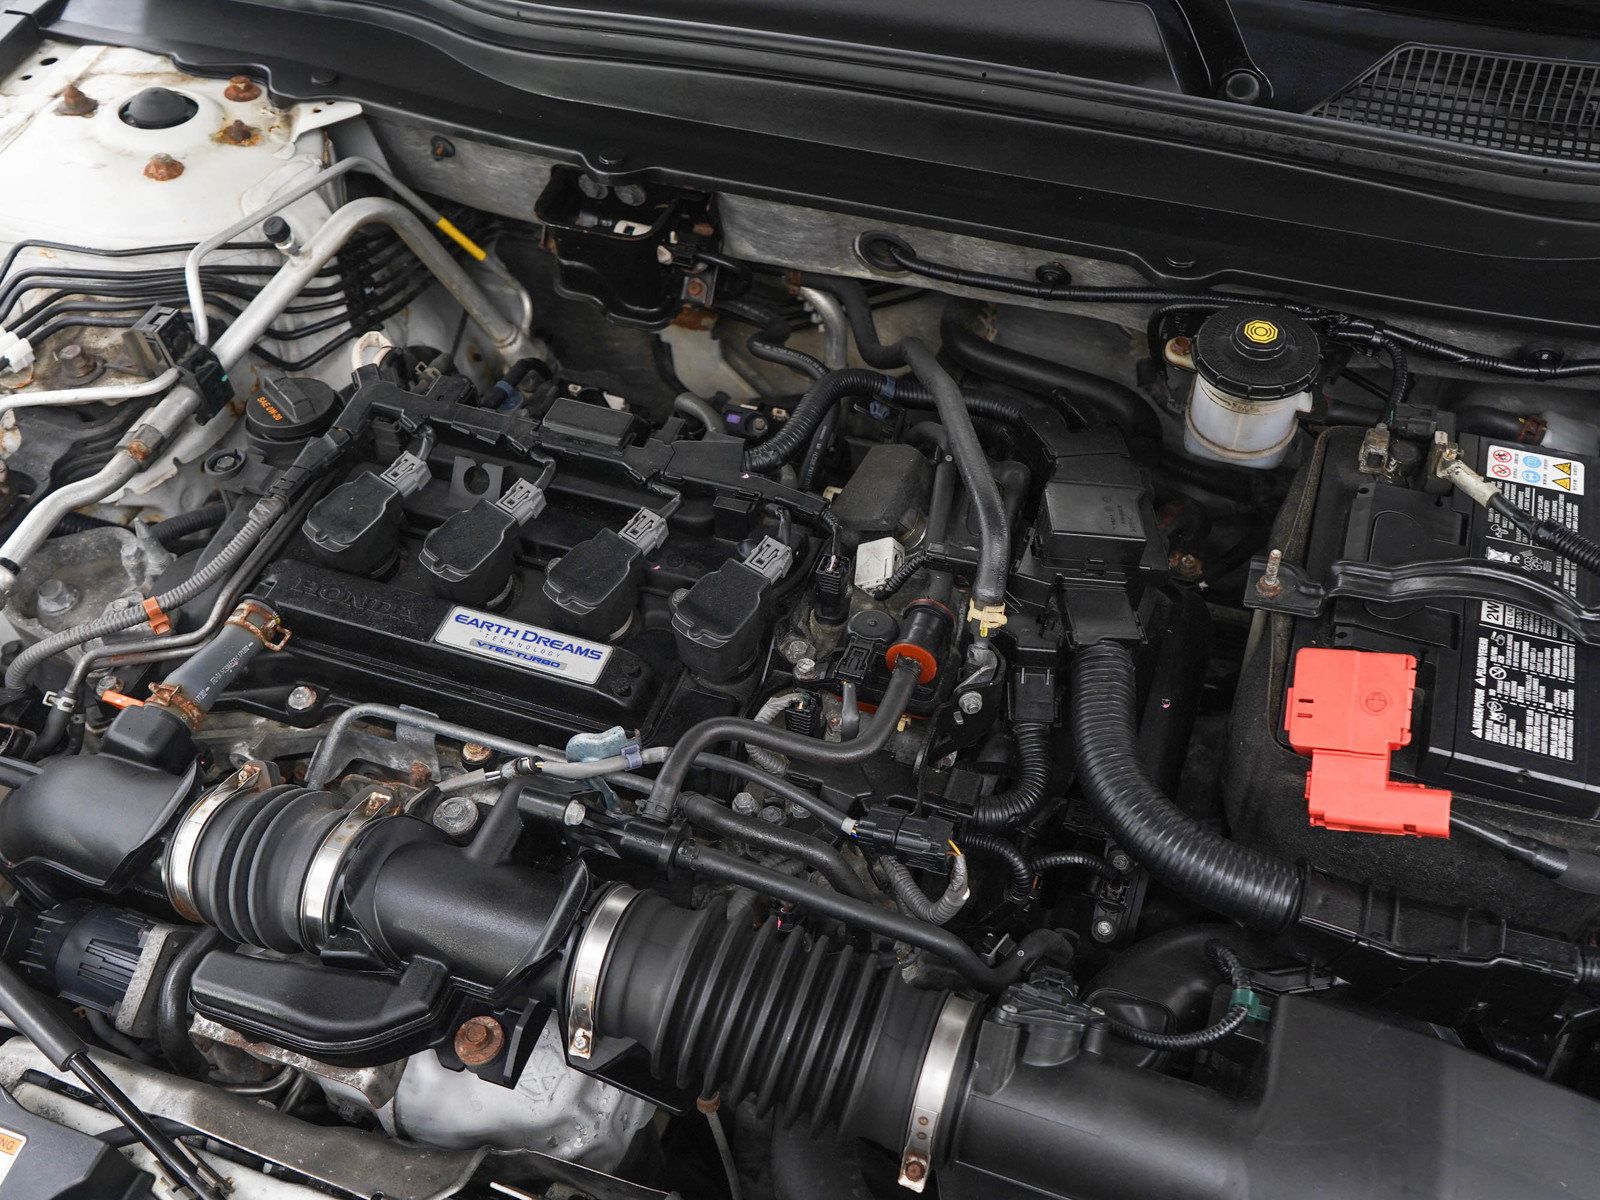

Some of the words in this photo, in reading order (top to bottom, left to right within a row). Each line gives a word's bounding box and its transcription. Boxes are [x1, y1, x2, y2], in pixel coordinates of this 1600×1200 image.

[1486, 601, 1500, 621] 2W
[454, 613, 520, 638] EARTH
[521, 630, 603, 660] DREAMS
[484, 633, 561, 658] TECHNOLOGY
